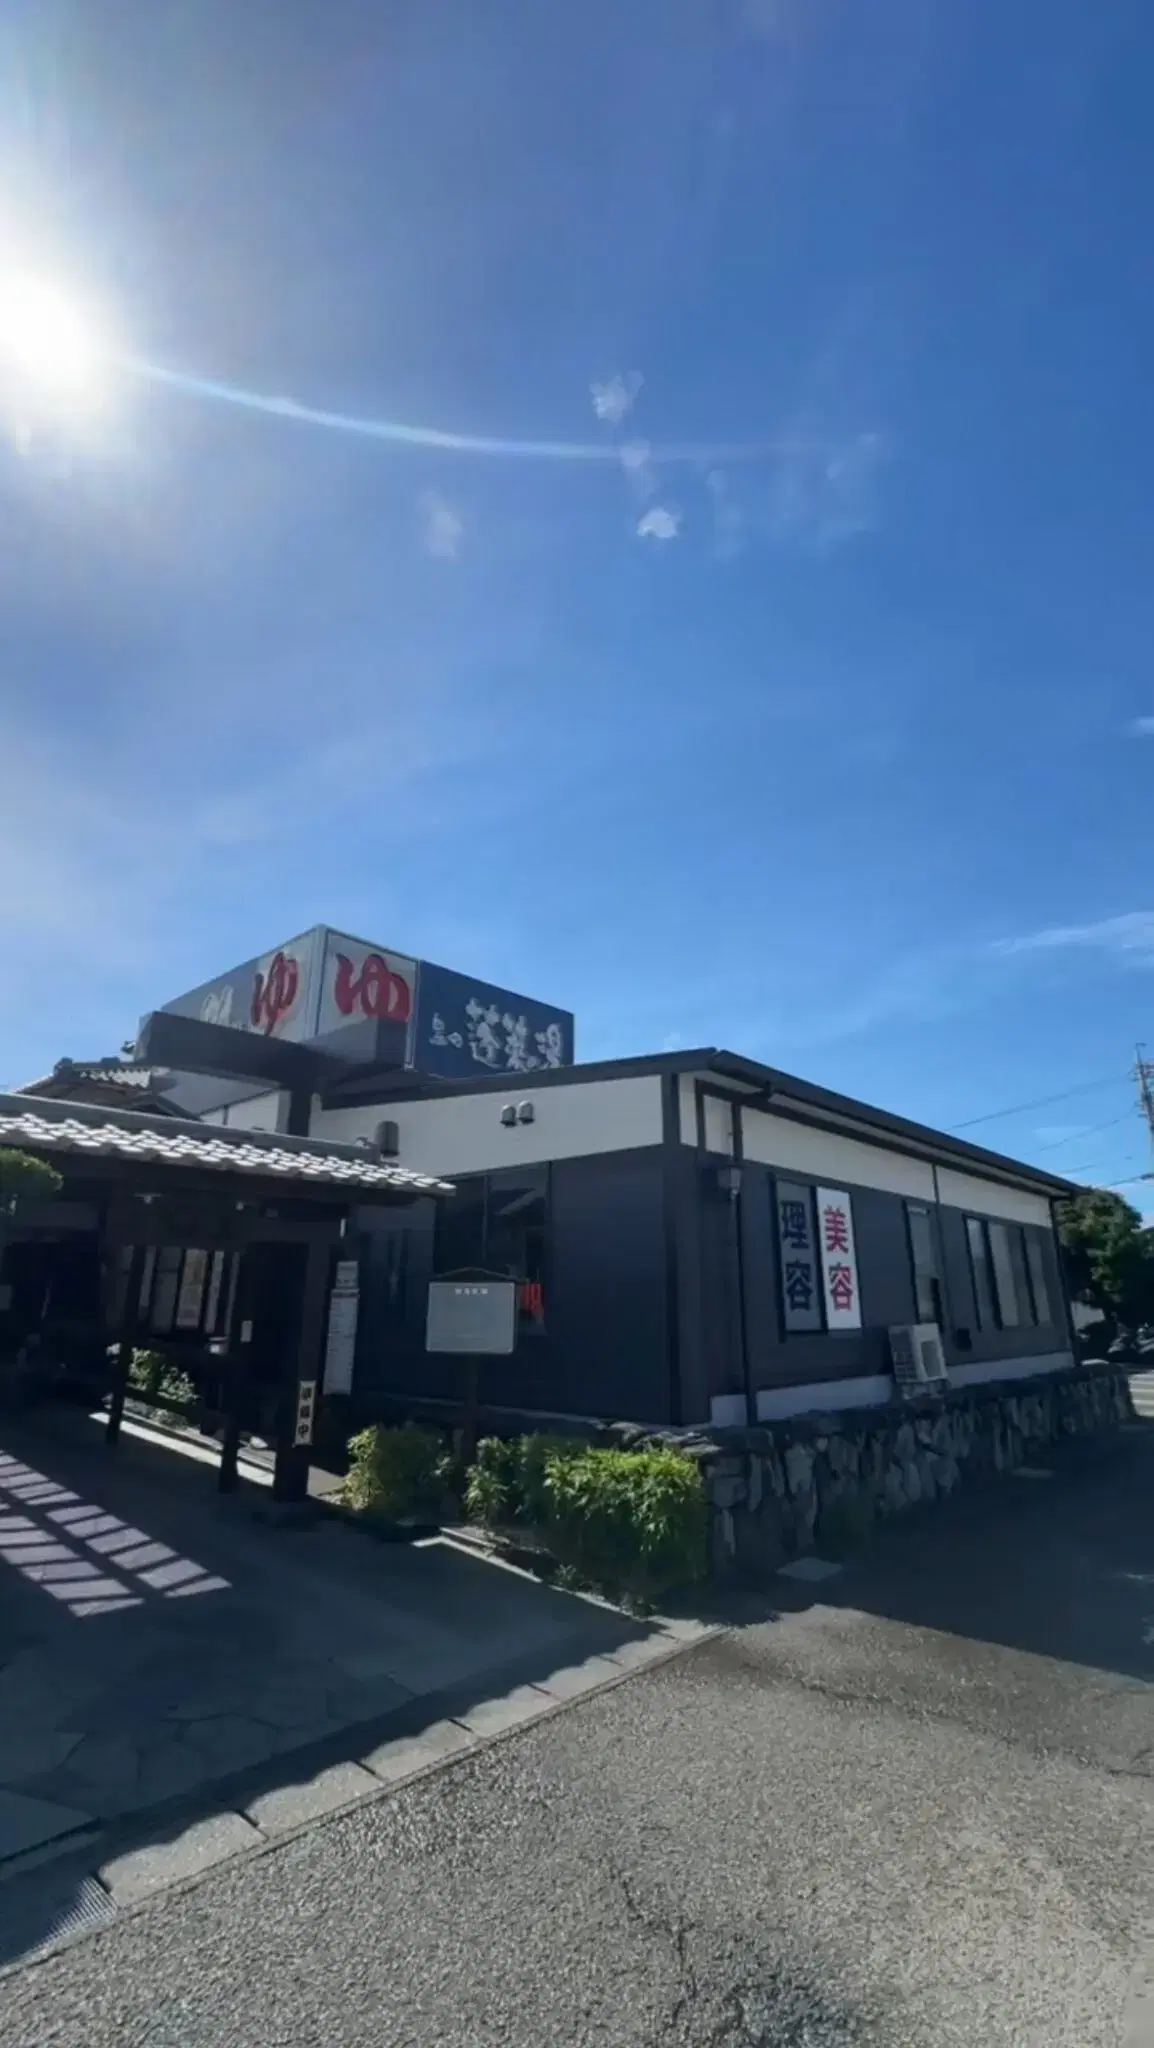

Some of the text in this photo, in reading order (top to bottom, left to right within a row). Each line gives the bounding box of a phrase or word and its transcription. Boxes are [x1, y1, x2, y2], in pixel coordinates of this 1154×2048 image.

[251, 952, 298, 1035] ゆ
[335, 954, 410, 1021] ゆ
[781, 1201, 813, 1311] 理容
[823, 1203, 853, 1312] 美容
